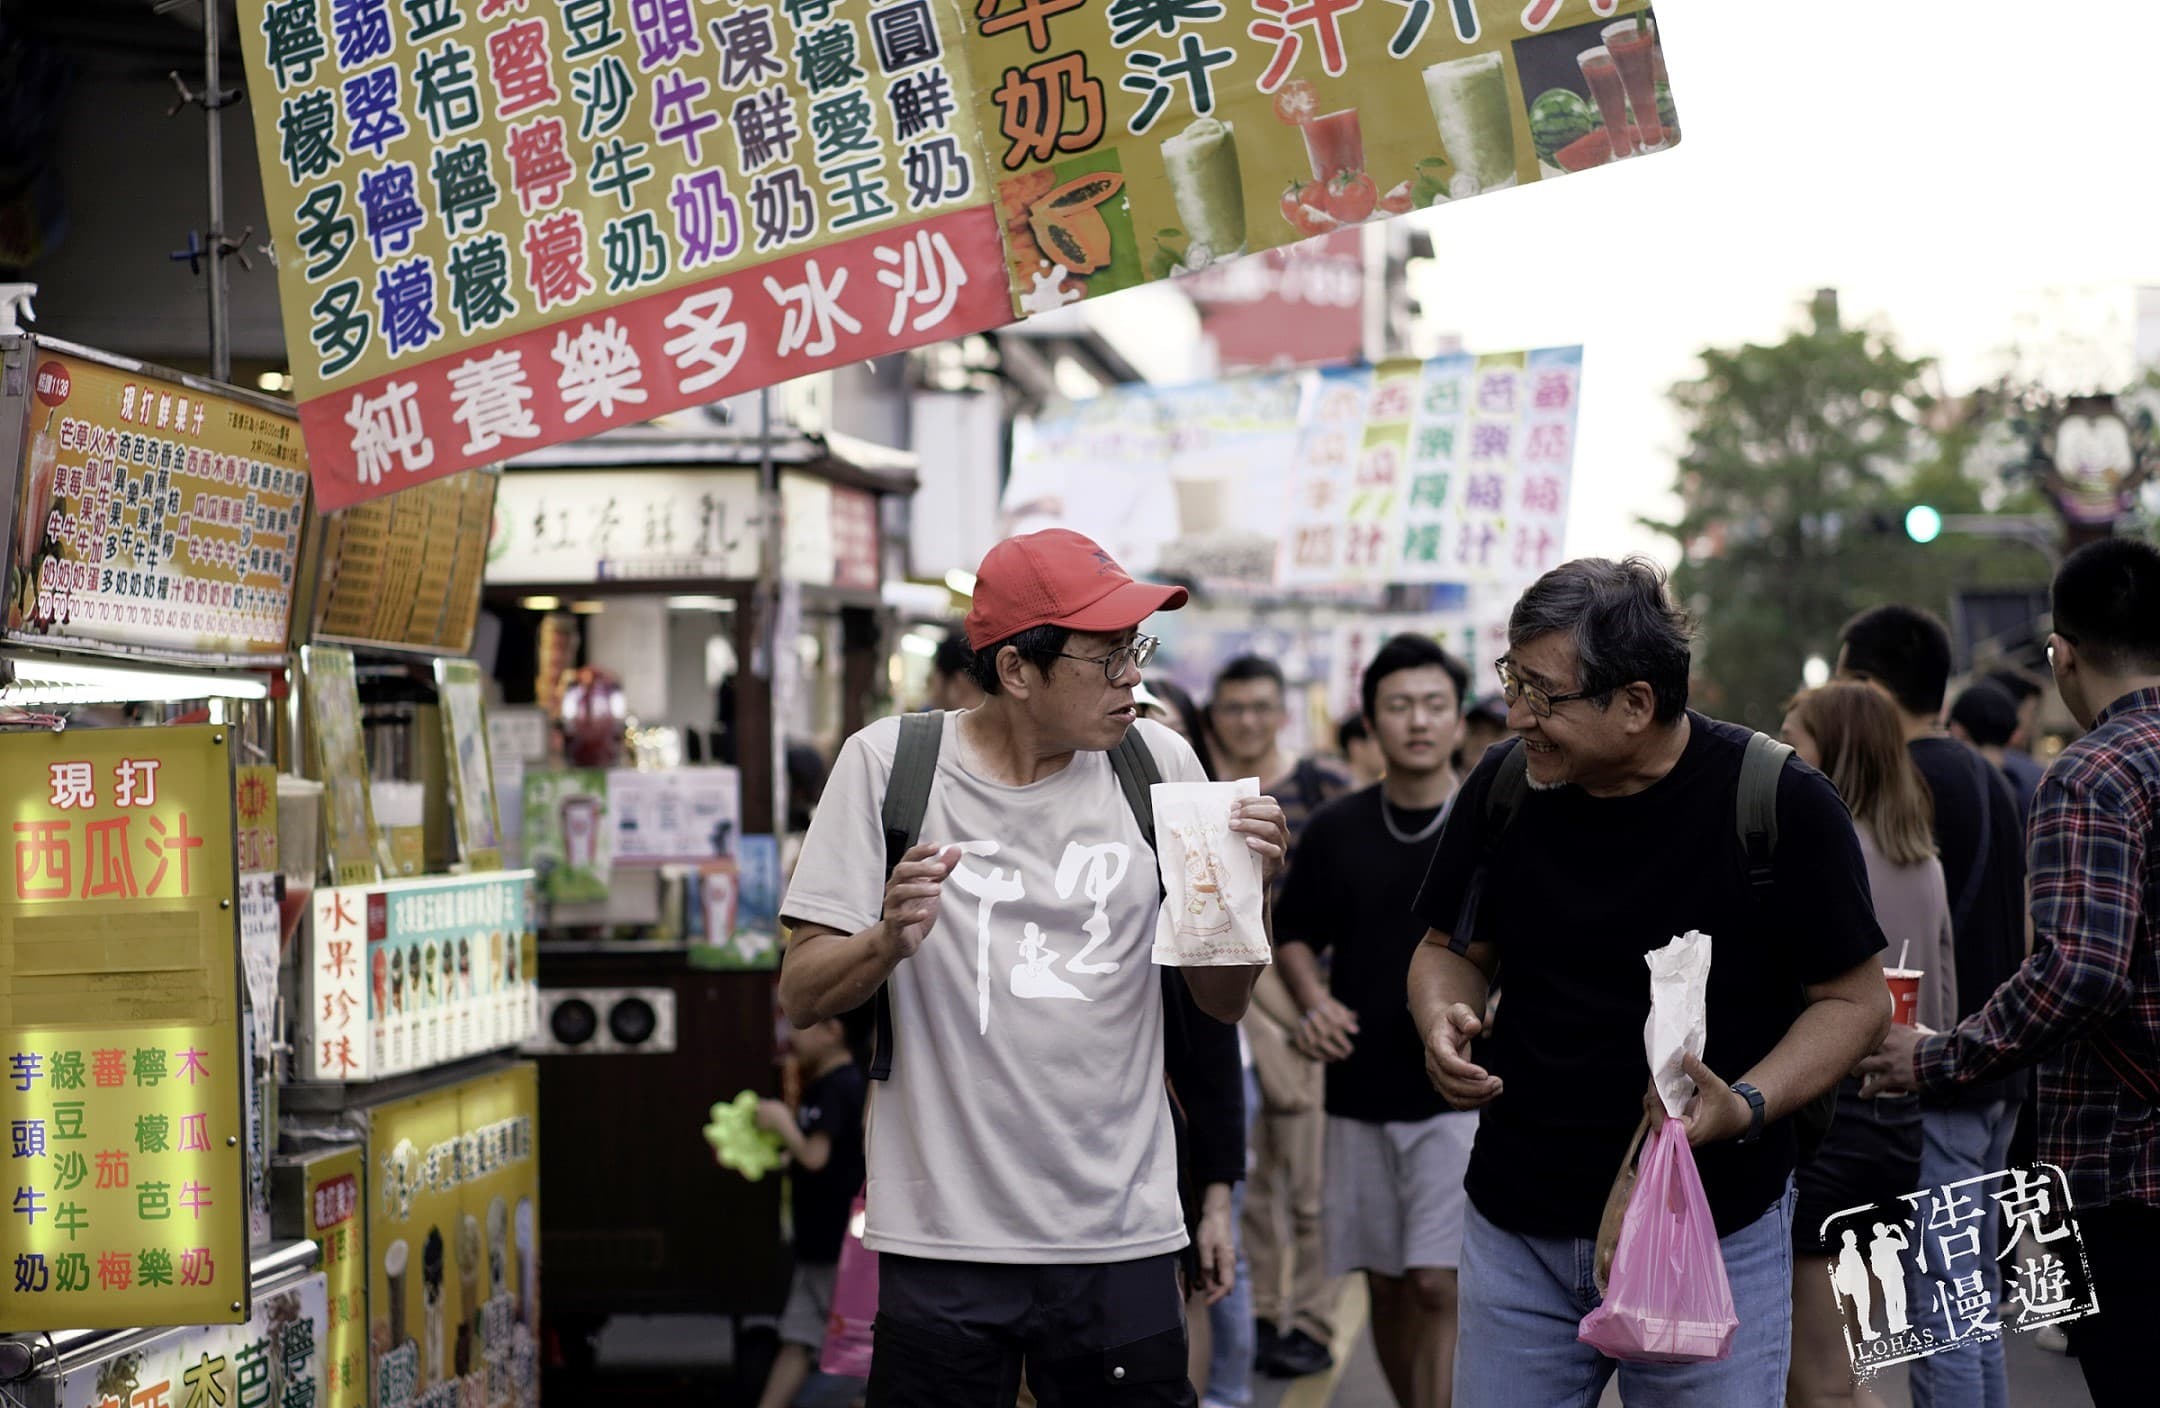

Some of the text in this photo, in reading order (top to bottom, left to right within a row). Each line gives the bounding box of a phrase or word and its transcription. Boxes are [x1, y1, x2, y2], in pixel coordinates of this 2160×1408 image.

[263, 0, 371, 378] 檸檬多多
[477, 0, 594, 305] 蜜檸檬
[120, 384, 206, 441] 現打鮮果汁
[347, 230, 968, 486] 純養樂多冰沙
[42, 420, 75, 590] 芒果牛奶
[56, 423, 89, 591] 草莓牛奶
[71, 427, 102, 592] 火龍果牛奶
[101, 434, 131, 594] 奇異果多多
[115, 437, 146, 596] 芭樂牛奶
[129, 440, 159, 598] 奇異果牛奶
[171, 449, 199, 601] 西瓜汁
[38, 596, 52, 620] 70
[53, 597, 67, 620] 70
[69, 599, 81, 619] 70
[84, 600, 96, 620] 70
[98, 602, 110, 622] 70
[113, 603, 125, 623] 70
[127, 604, 139, 624] 70
[140, 606, 152, 625] 70
[166, 611, 179, 628] 40
[13, 812, 204, 901] 西瓜汁
[50, 759, 160, 809] 現打
[320, 891, 359, 1081] 水果珍珠
[9, 1052, 49, 1293] 芋頭牛奶
[49, 1050, 91, 1293] 綠豆沙牛奶
[91, 1048, 133, 1291] 蕃茄梅
[132, 1047, 174, 1289] 檸檬芭樂
[174, 1046, 216, 1287] 木瓜牛奶
